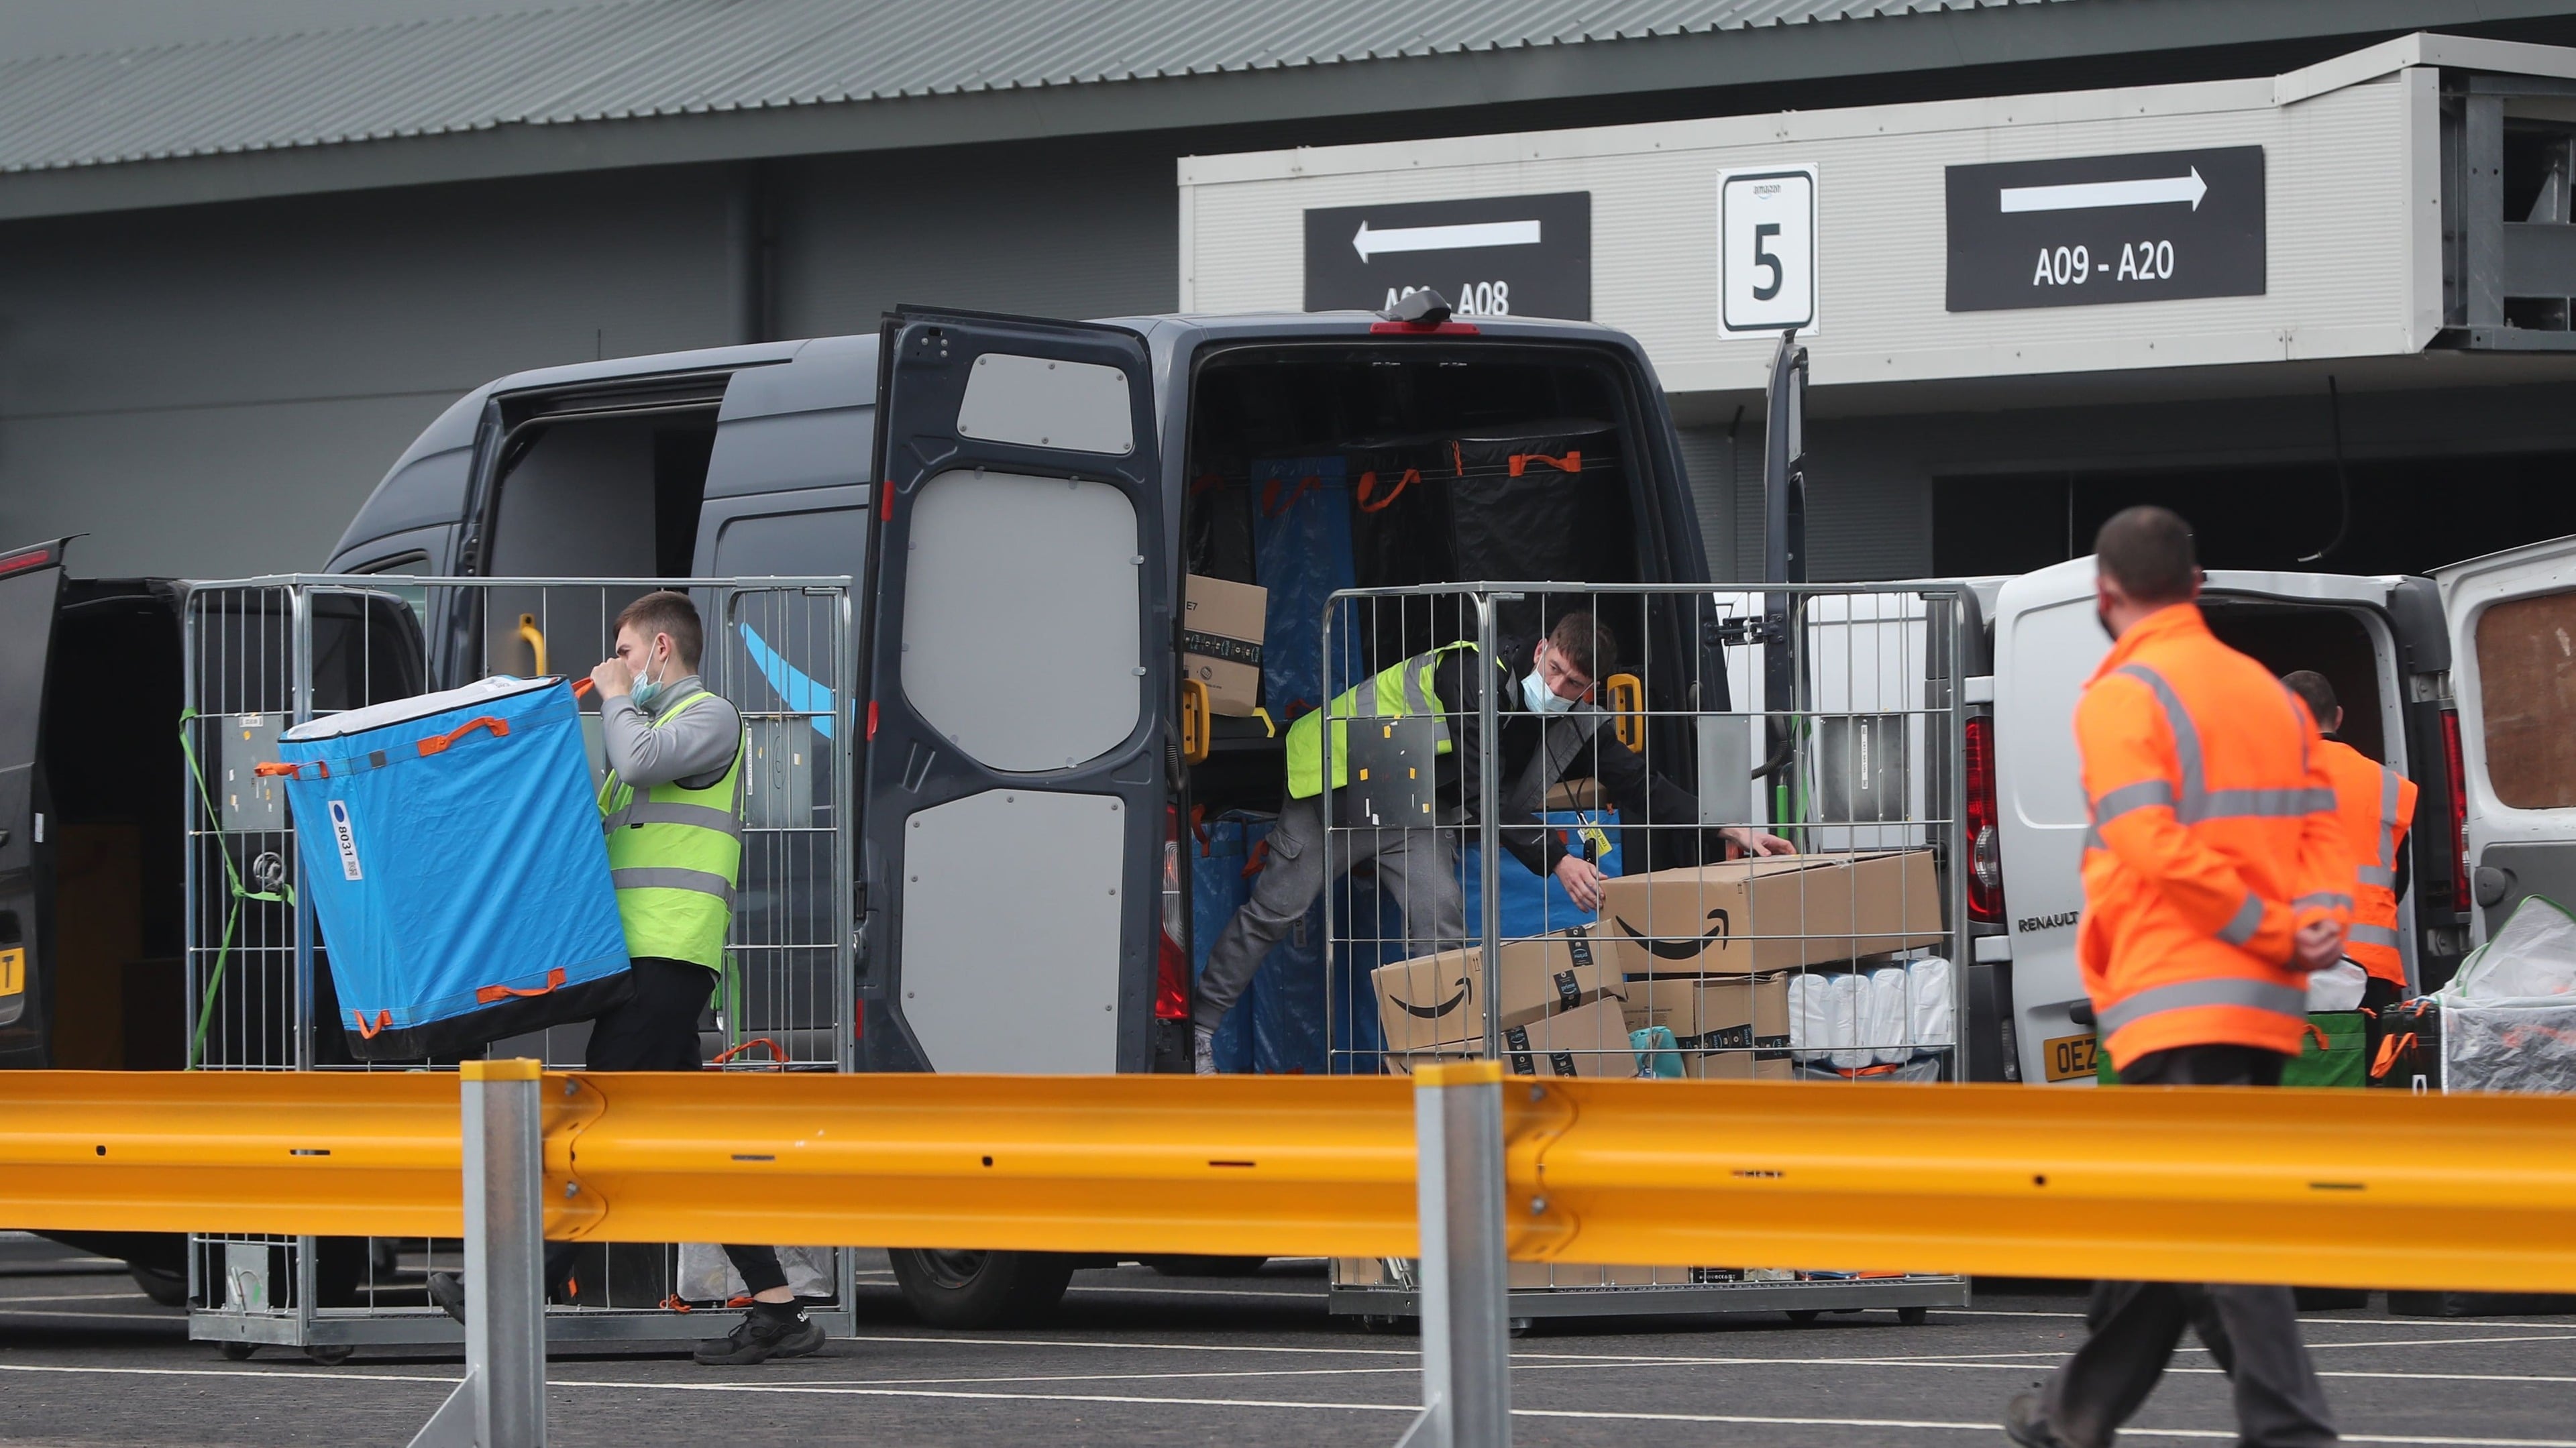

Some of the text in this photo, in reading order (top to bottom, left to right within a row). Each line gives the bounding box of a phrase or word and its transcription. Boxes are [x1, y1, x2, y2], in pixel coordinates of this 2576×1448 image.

[1752, 183, 1782, 194] amazon
[1753, 223, 1783, 301] 5
[2033, 239, 2175, 286] A09 - A20
[1457, 280, 1509, 315] A08
[1185, 601, 1198, 611] E7
[338, 826, 354, 857] 8031
[2018, 911, 2079, 933] RENAULT
[1560, 983, 1576, 993] prime
[2057, 1038, 2097, 1073] OEZ
